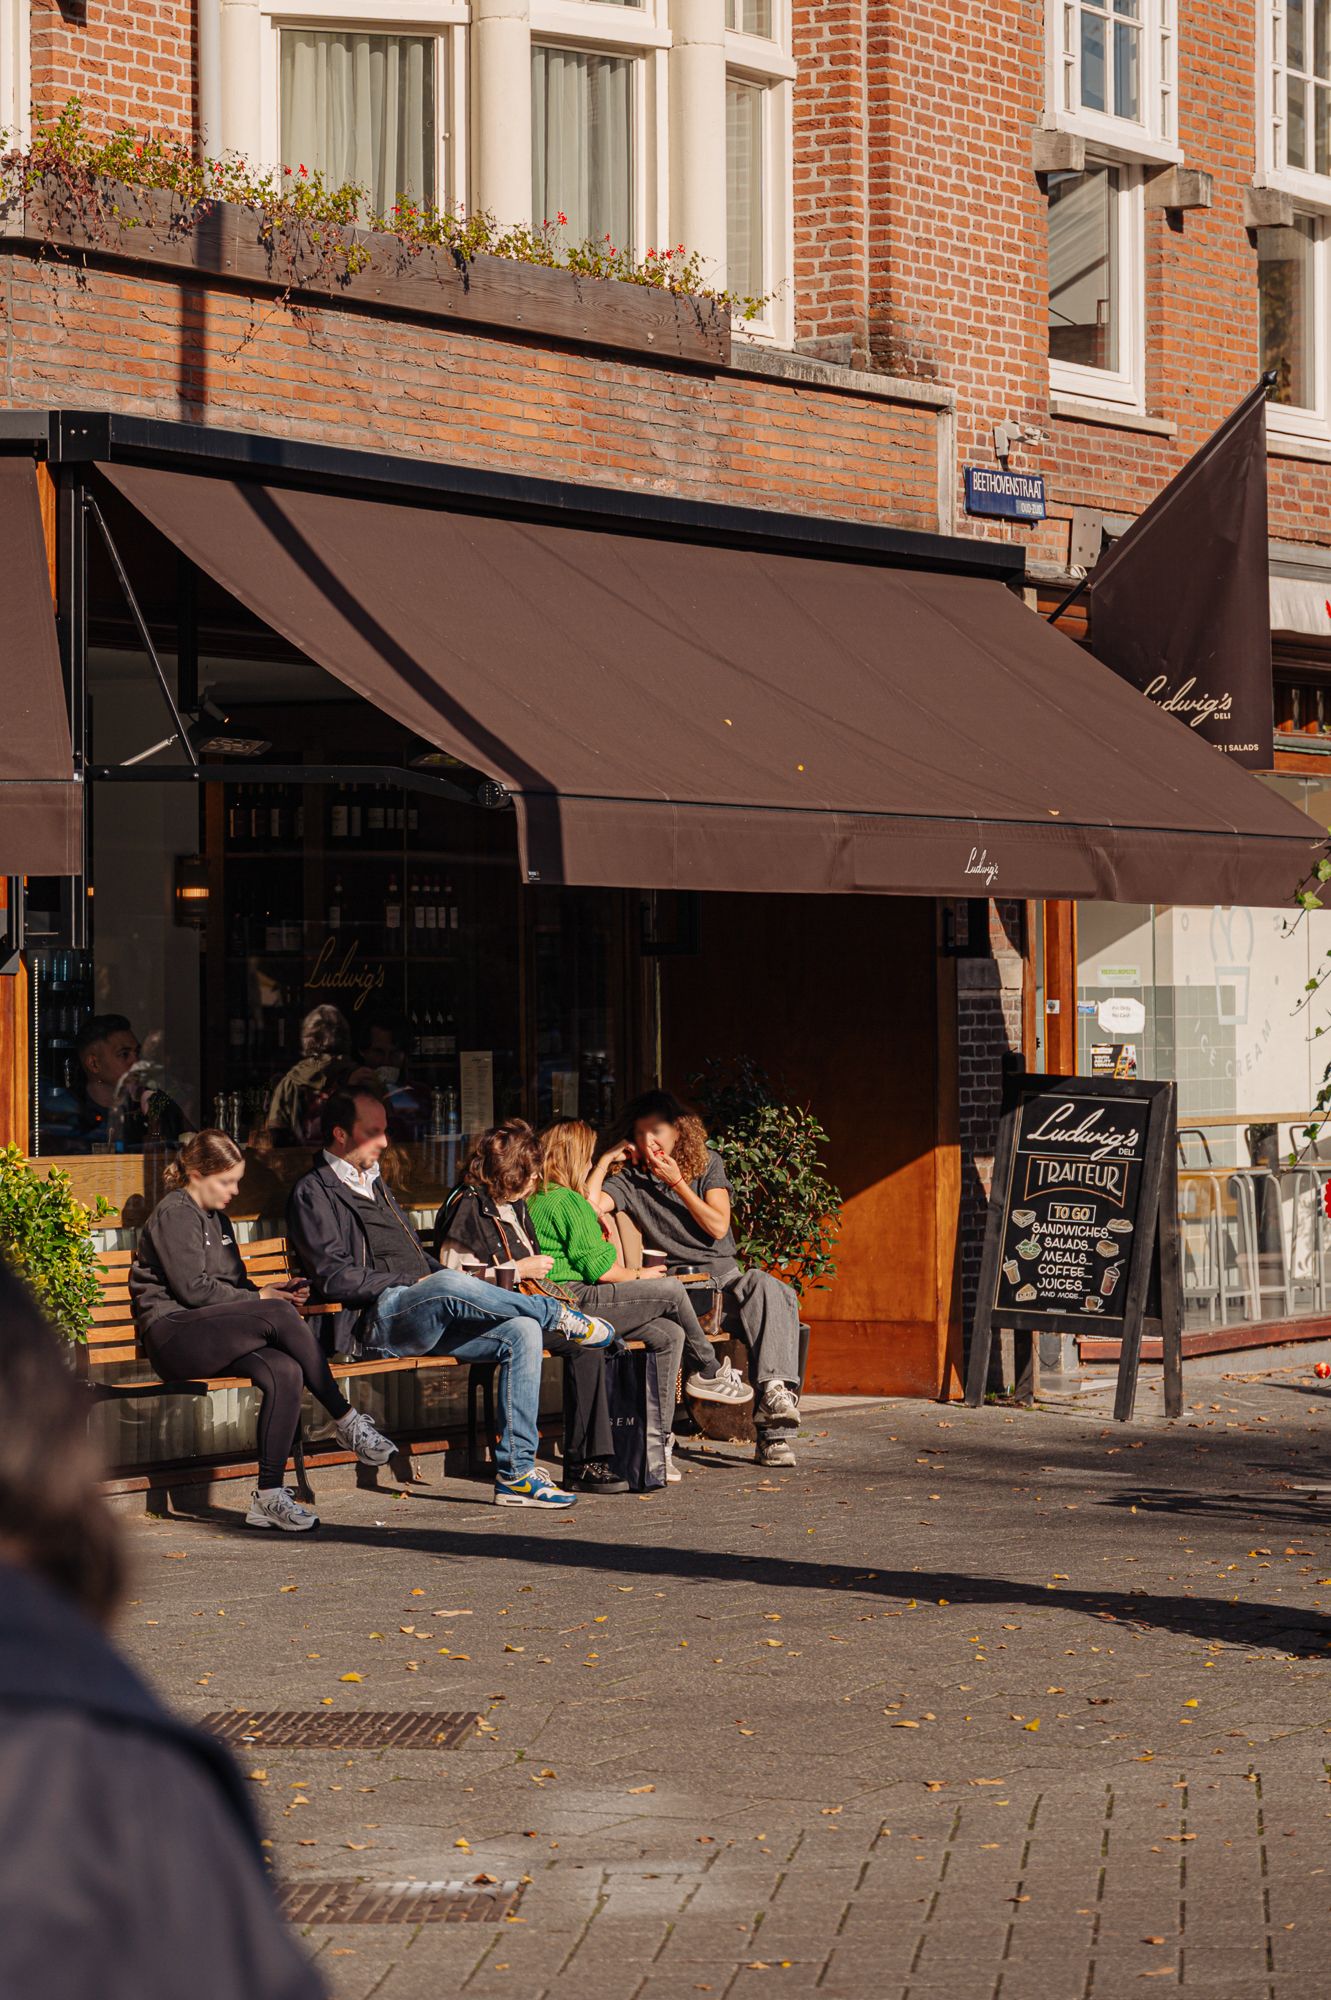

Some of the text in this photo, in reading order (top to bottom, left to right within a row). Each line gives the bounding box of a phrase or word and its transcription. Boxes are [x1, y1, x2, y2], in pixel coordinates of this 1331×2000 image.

[972, 471, 1042, 499] BEETHOVENSTRAAT
[1213, 712, 1232, 720] DELI
[1228, 743, 1260, 752] SALADS
[964, 846, 999, 886] Ludwig's
[303, 936, 385, 1011] Ludwig's
[1194, 1018, 1272, 1078] ICE CREAM
[1027, 1103, 1139, 1161] Ludwig's
[1118, 1146, 1135, 1156] DELI
[1036, 1160, 1122, 1197] TRAITEUR
[1054, 1205, 1090, 1221] TO GO
[1040, 1290, 1055, 1298] AND
